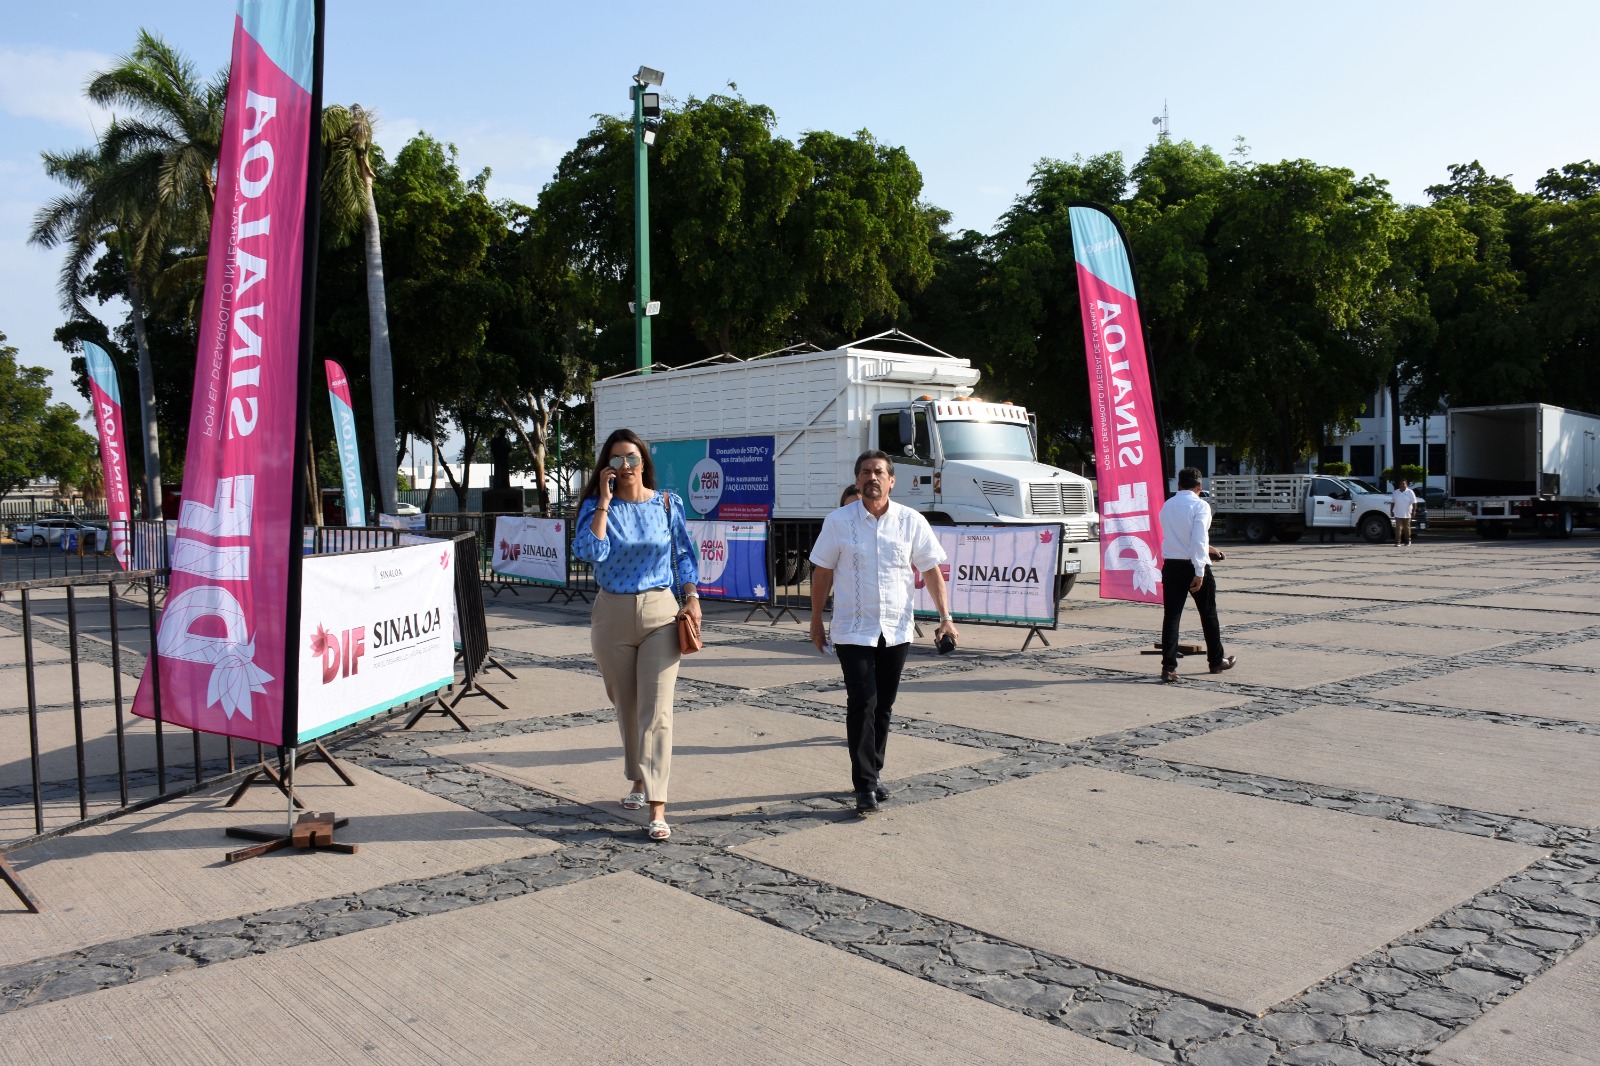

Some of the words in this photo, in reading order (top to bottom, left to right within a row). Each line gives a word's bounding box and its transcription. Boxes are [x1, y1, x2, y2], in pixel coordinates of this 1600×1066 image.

[716, 447, 741, 455] Donativo
[746, 446, 765, 455] SEPyC
[764, 447, 769, 455] y
[729, 455, 763, 464] trabajadores
[700, 471, 719, 480] AQUA
[700, 479, 719, 490] TON
[724, 483, 769, 492] #AQUATON2023
[701, 539, 724, 549] AQUA
[522, 544, 558, 559] SINALOA
[701, 548, 724, 561] TON
[380, 568, 403, 580] SINALOA
[957, 564, 1040, 584] SINALOA
[322, 626, 366, 685] DIF
[373, 607, 441, 649] SINALOA
